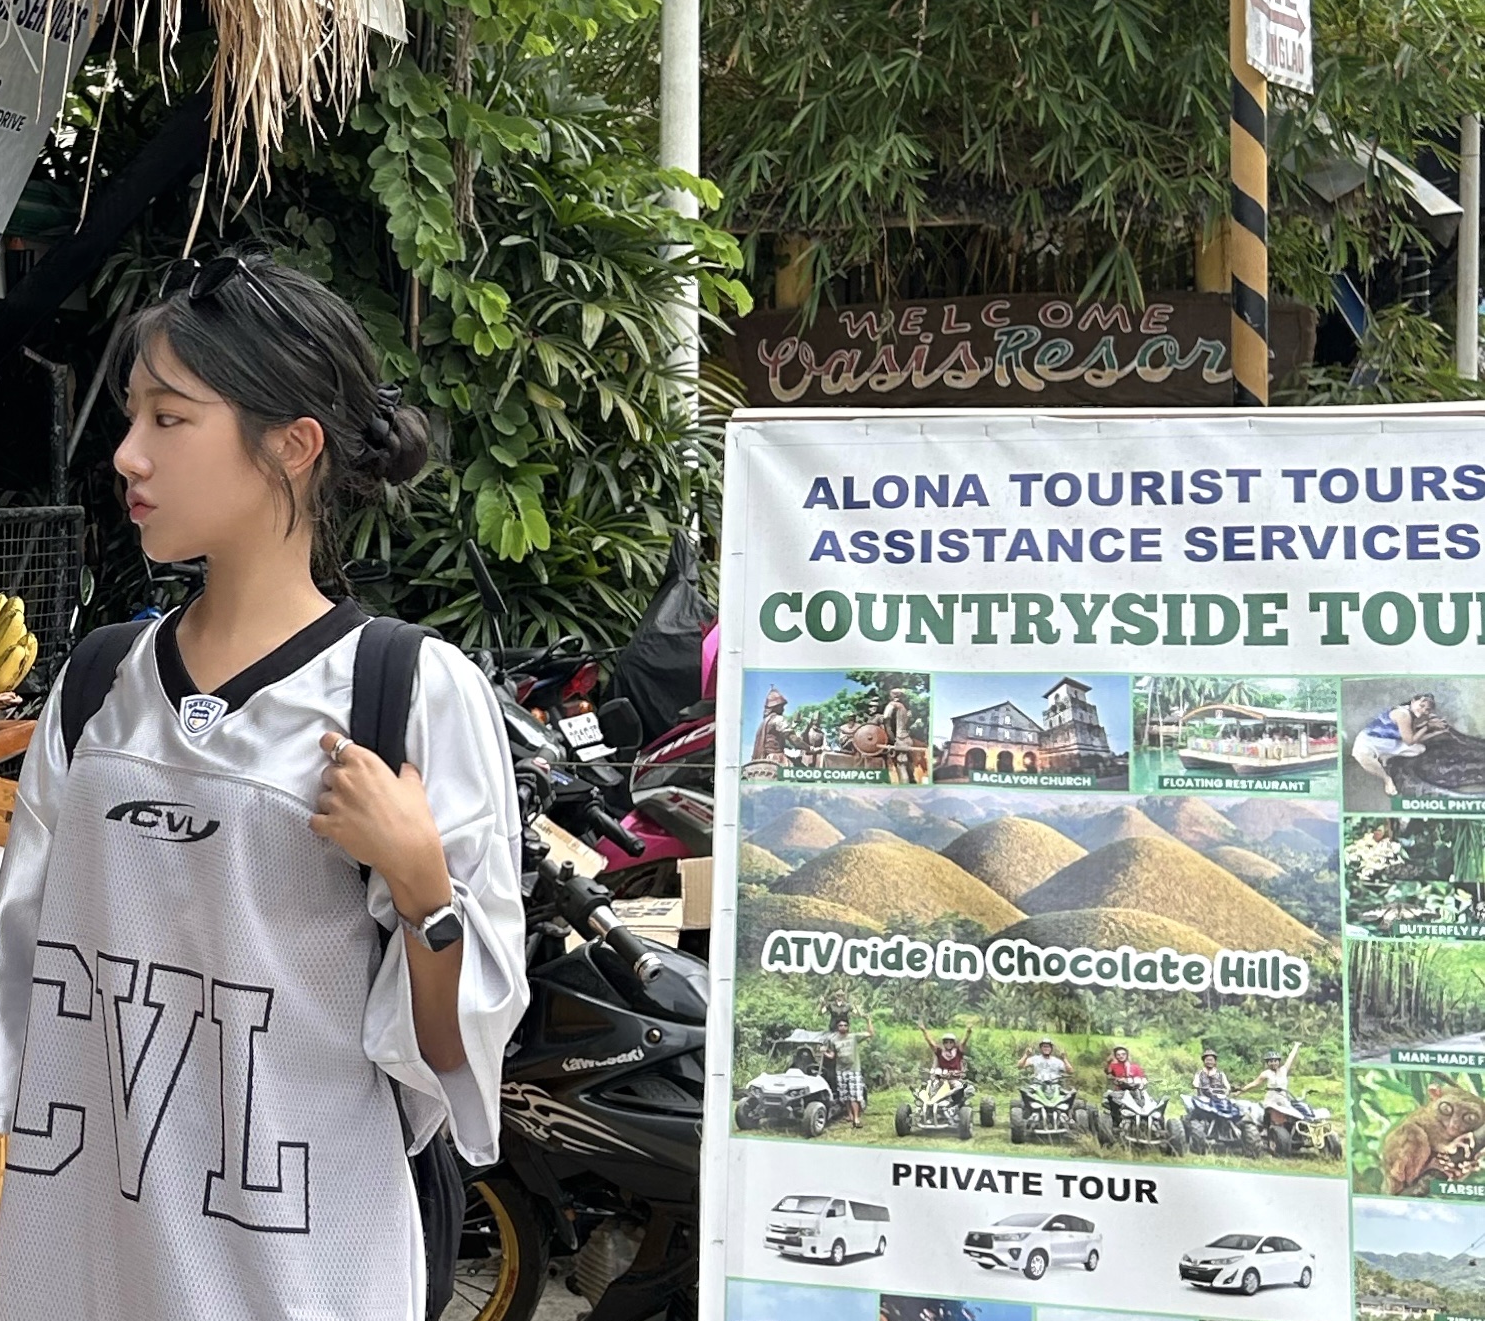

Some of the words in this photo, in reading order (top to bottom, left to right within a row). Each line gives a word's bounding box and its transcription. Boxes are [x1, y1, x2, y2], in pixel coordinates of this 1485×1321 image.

[839, 300, 1175, 342] WELCOME
[757, 334, 995, 403] Oasis
[803, 474, 991, 510] ALONA
[1009, 468, 1262, 508] TOURIST
[1280, 464, 1485, 503] TOURS
[809, 526, 1164, 564] ASSISTANCE
[1182, 523, 1482, 562] SERVICES
[758, 588, 1290, 648] COUNTRYSIDE
[1309, 588, 1485, 647] TOU
[783, 769, 822, 780] BLOOD
[823, 769, 883, 781] COMPACT
[973, 772, 1039, 787] BACLAYON
[1040, 775, 1093, 787] CHURCH
[1162, 777, 1225, 789] FLOATING
[1224, 778, 1306, 792] RESTAURANT
[1401, 799, 1446, 811] BOHOL
[1399, 924, 1468, 936] BUTTERFLY
[767, 935, 837, 968] ATV
[847, 942, 929, 972] ride
[942, 946, 979, 975] in
[990, 944, 1206, 986] Chocolate
[1220, 955, 1303, 991] Hills
[1397, 1051, 1476, 1065] MAN-MADE
[5, 939, 311, 1235] CVL
[892, 1162, 1044, 1196] PRIVATE
[1054, 1173, 1160, 1205] TOUR
[1438, 1182, 1485, 1196] TARSIE
